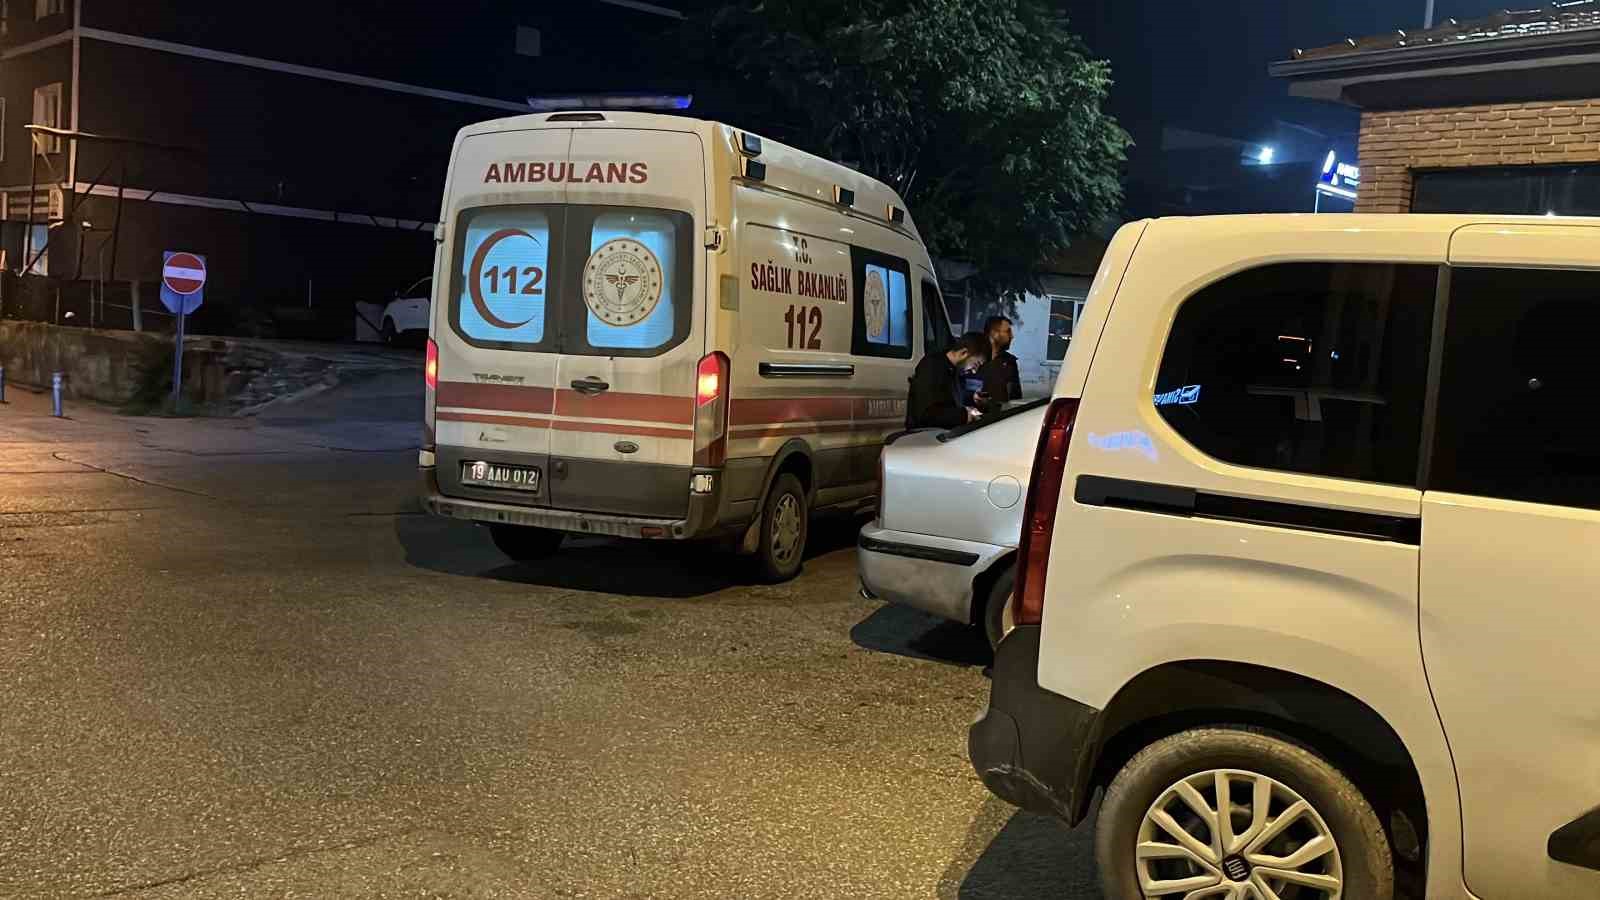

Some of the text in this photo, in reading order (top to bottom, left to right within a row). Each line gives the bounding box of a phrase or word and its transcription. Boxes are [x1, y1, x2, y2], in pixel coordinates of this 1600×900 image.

[484, 162, 648, 183] AMBULANS
[792, 236, 812, 264] T.C.
[484, 266, 543, 294] 112
[751, 260, 847, 302] SAĞLIK BAKANLIĞI
[785, 304, 822, 350] 112
[471, 465, 536, 485] 19 AAU 012
